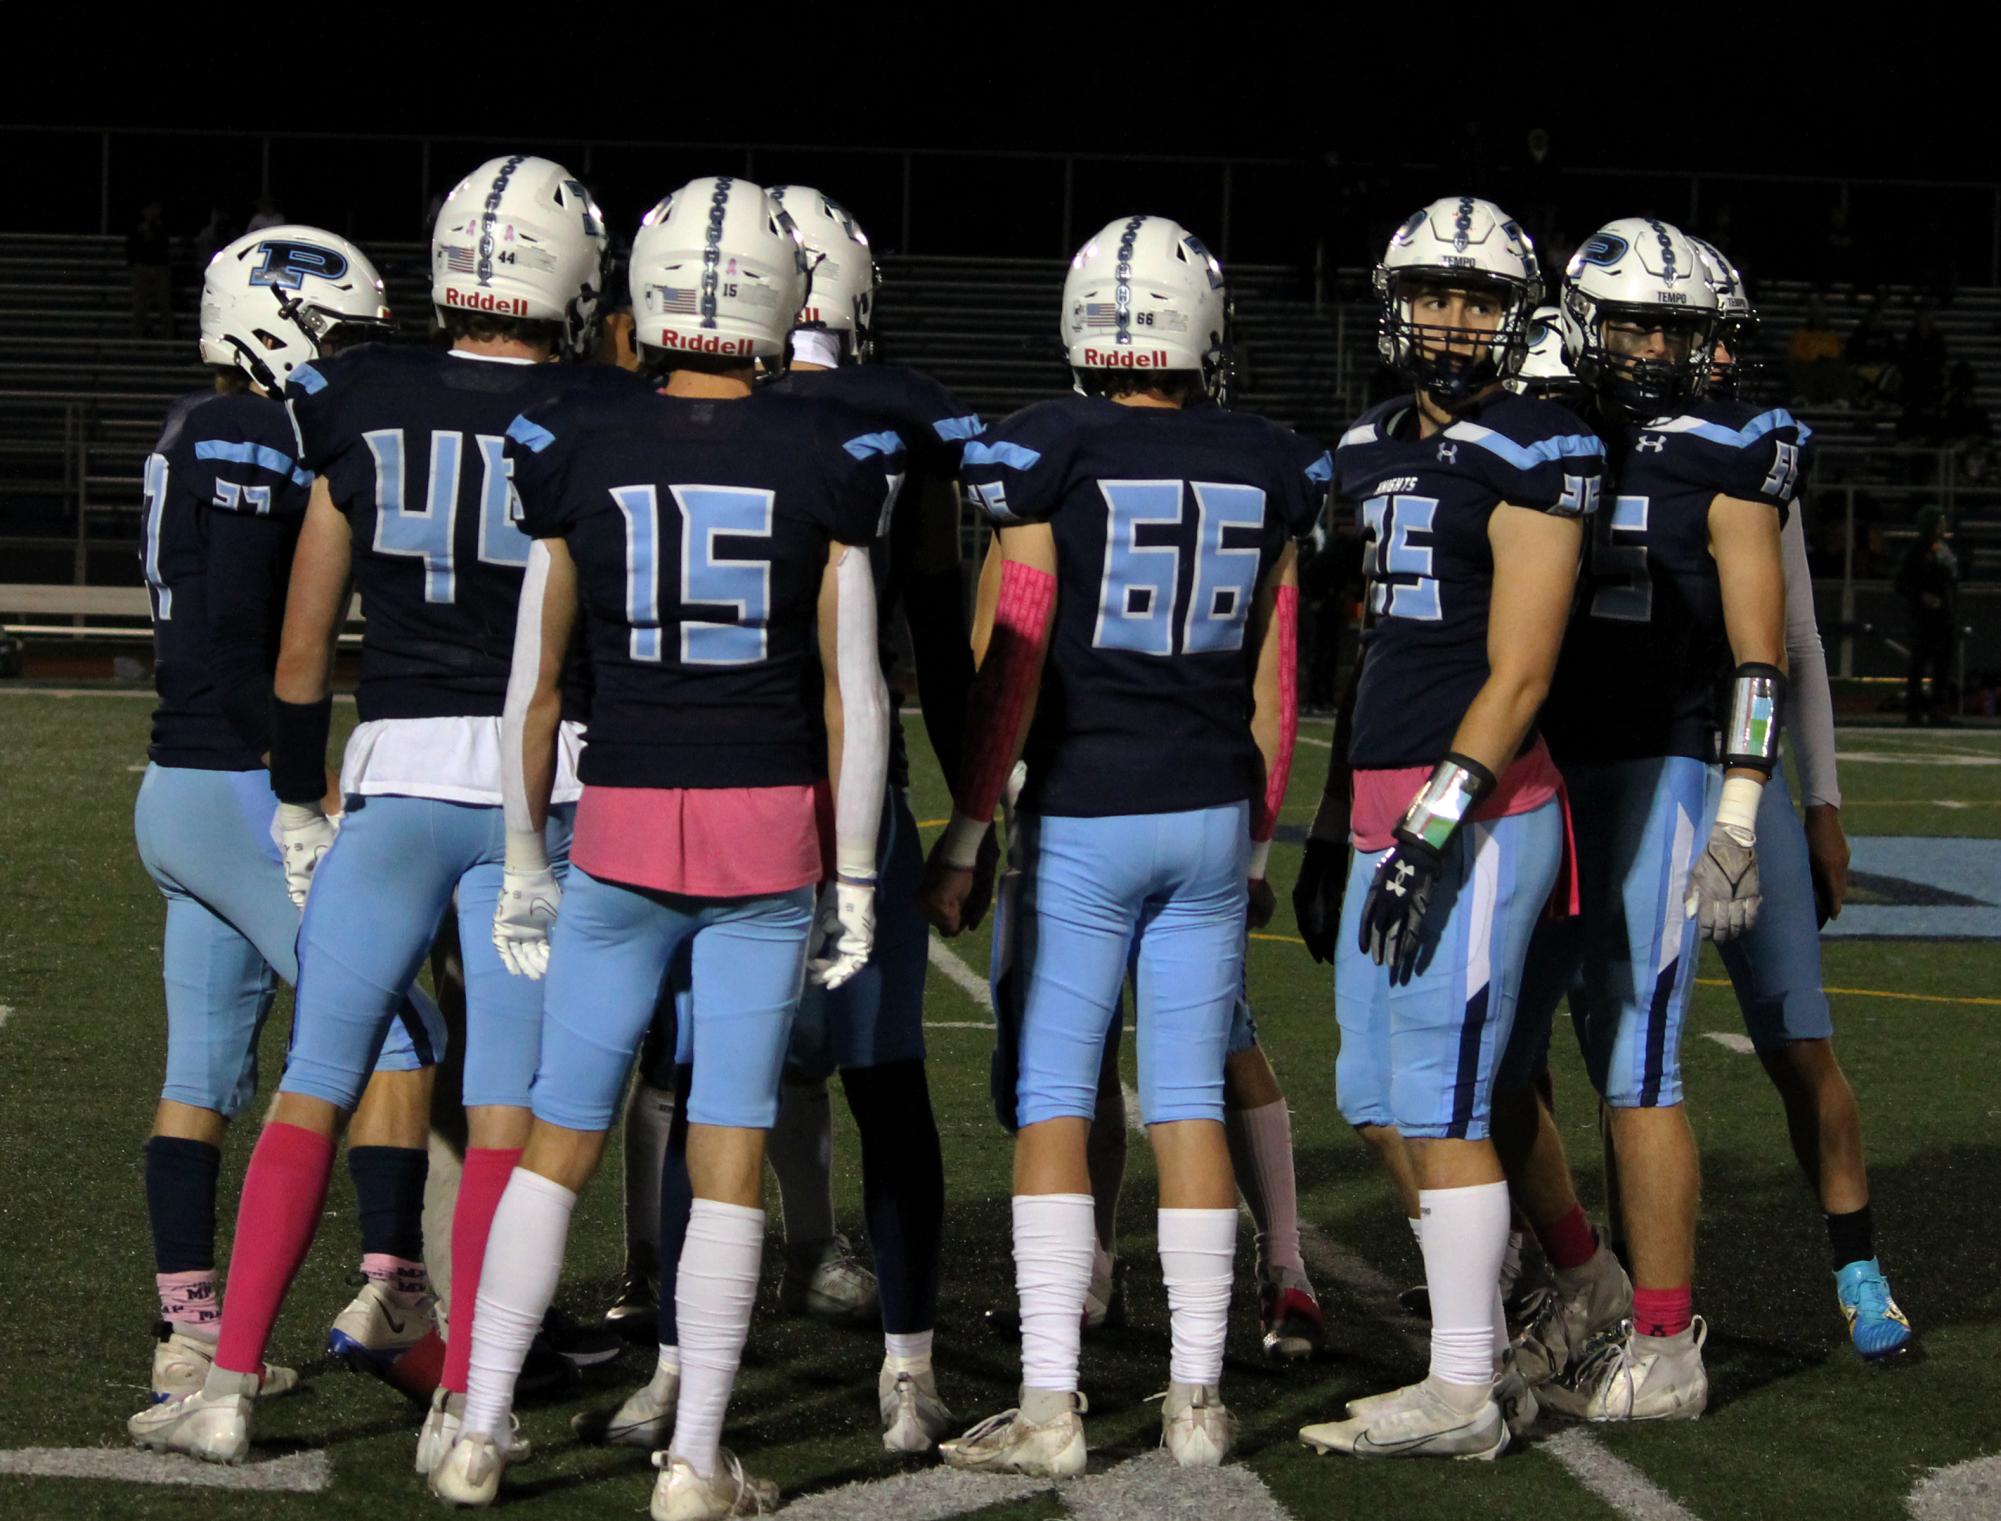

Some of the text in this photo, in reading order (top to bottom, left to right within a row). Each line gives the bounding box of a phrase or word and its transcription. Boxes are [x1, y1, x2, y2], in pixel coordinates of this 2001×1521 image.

[249, 240, 348, 290] P
[498, 251, 515, 265] 44
[723, 283, 738, 297] 15
[1658, 292, 1687, 304] TEMPO
[446, 288, 528, 317] Riddell
[1137, 312, 1154, 325] 66
[661, 329, 754, 356] Riddell
[1084, 348, 1167, 367] Riddell
[608, 484, 775, 664] 15
[1092, 479, 1266, 656] 66
